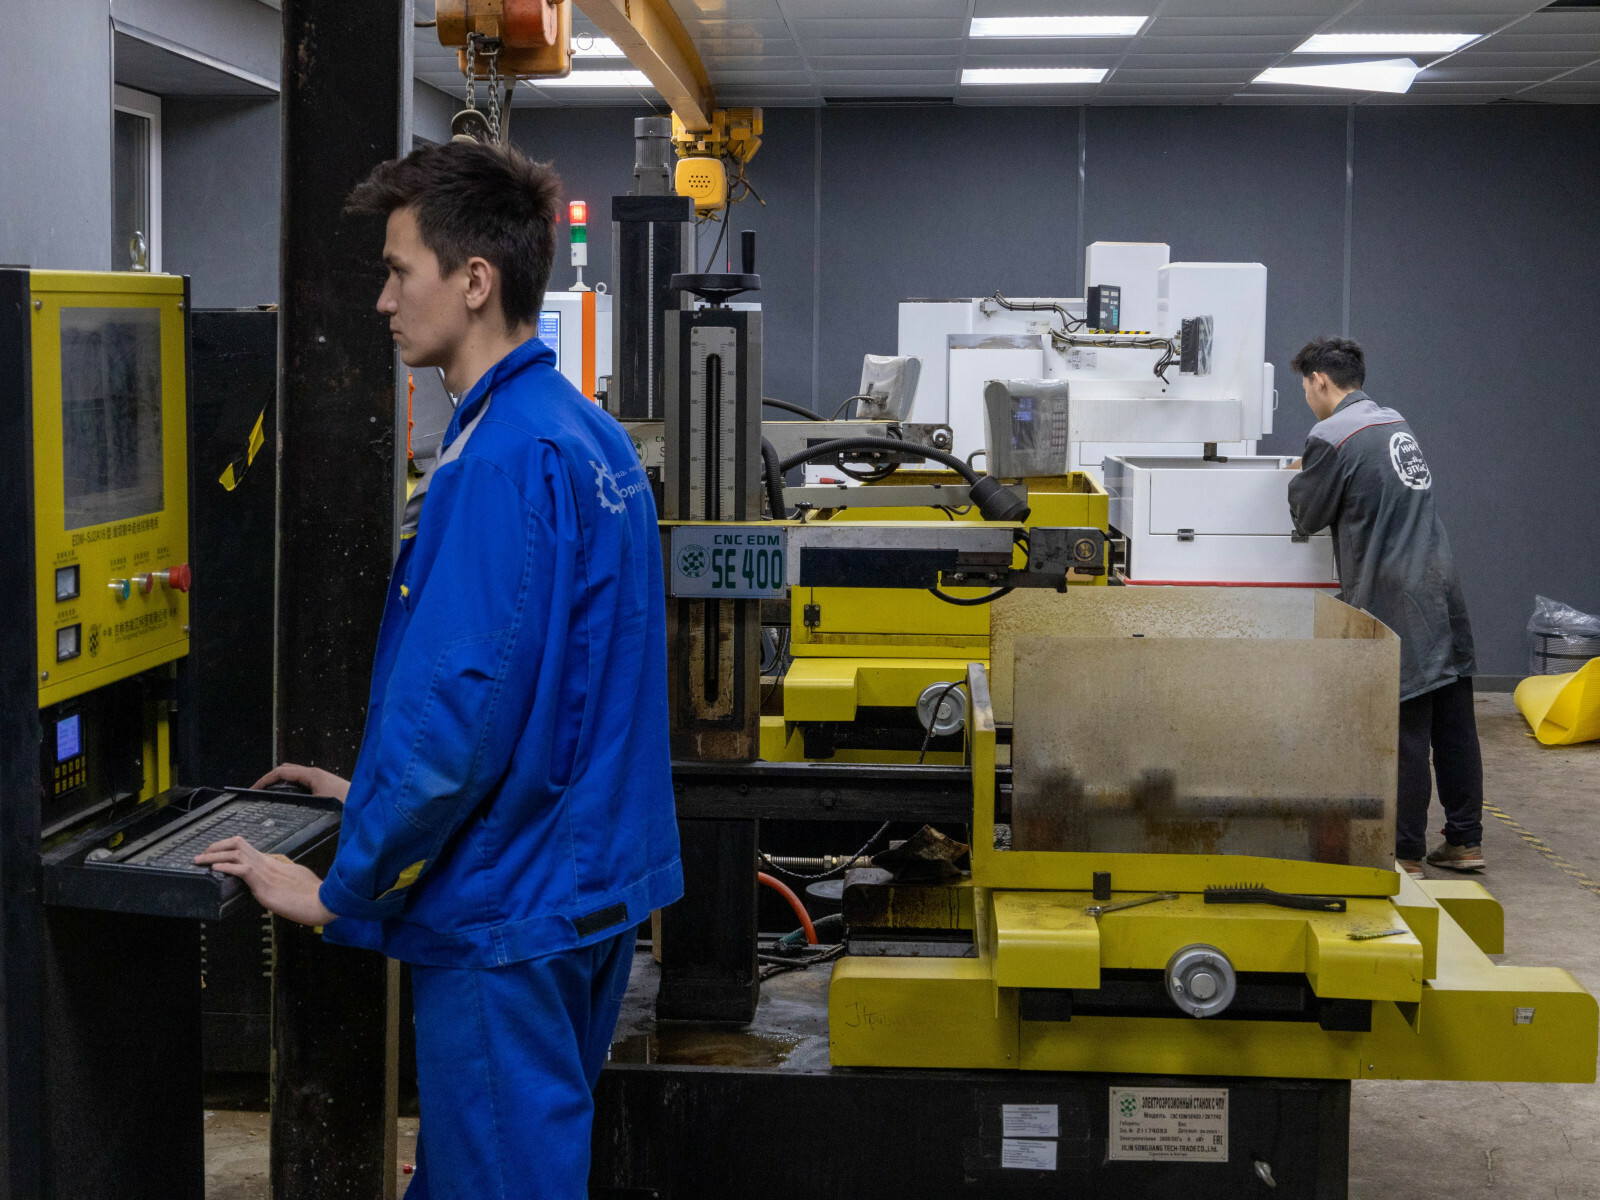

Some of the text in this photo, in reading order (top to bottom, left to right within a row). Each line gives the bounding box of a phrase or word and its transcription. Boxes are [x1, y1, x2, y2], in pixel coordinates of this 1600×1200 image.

[714, 534, 780, 545] CNC EDM
[712, 548, 783, 589] SE 400
